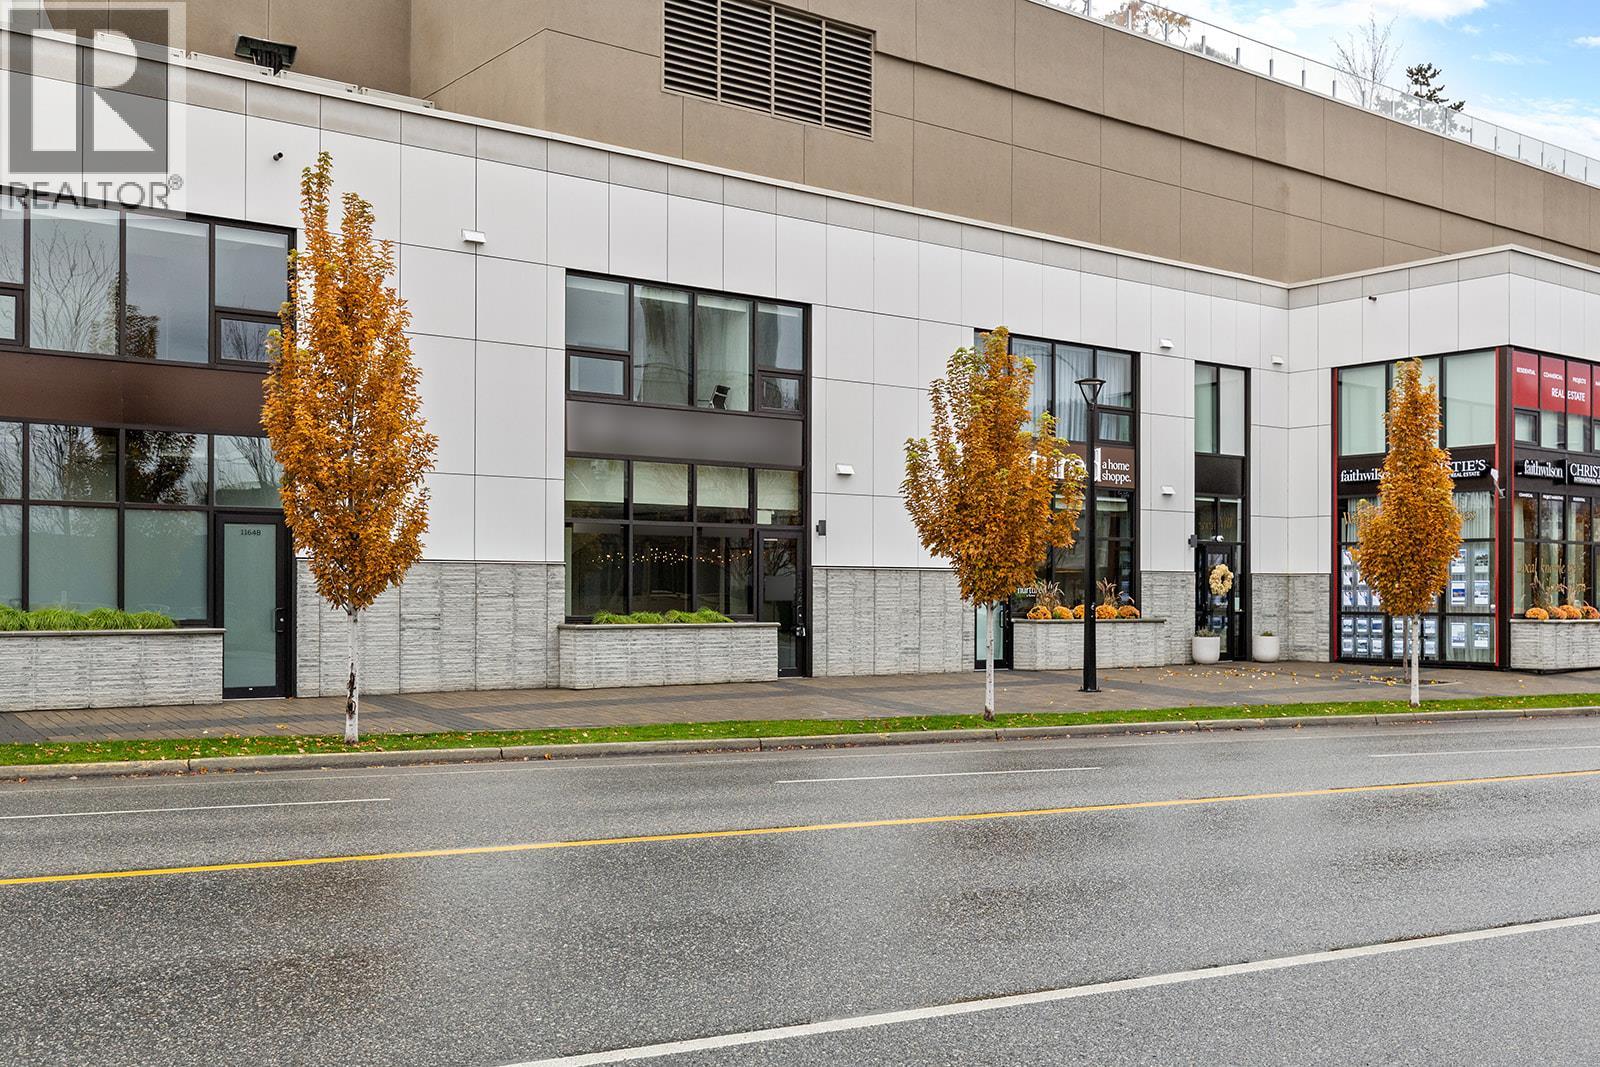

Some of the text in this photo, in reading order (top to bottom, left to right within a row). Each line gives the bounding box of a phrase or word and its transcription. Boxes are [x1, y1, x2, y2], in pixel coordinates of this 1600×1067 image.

[1551, 387, 1586, 402] REAL ESTATE
[1108, 458, 1130, 471] home
[1524, 459, 1564, 478] faithwilson
[1102, 470, 1132, 485] shoppe.
